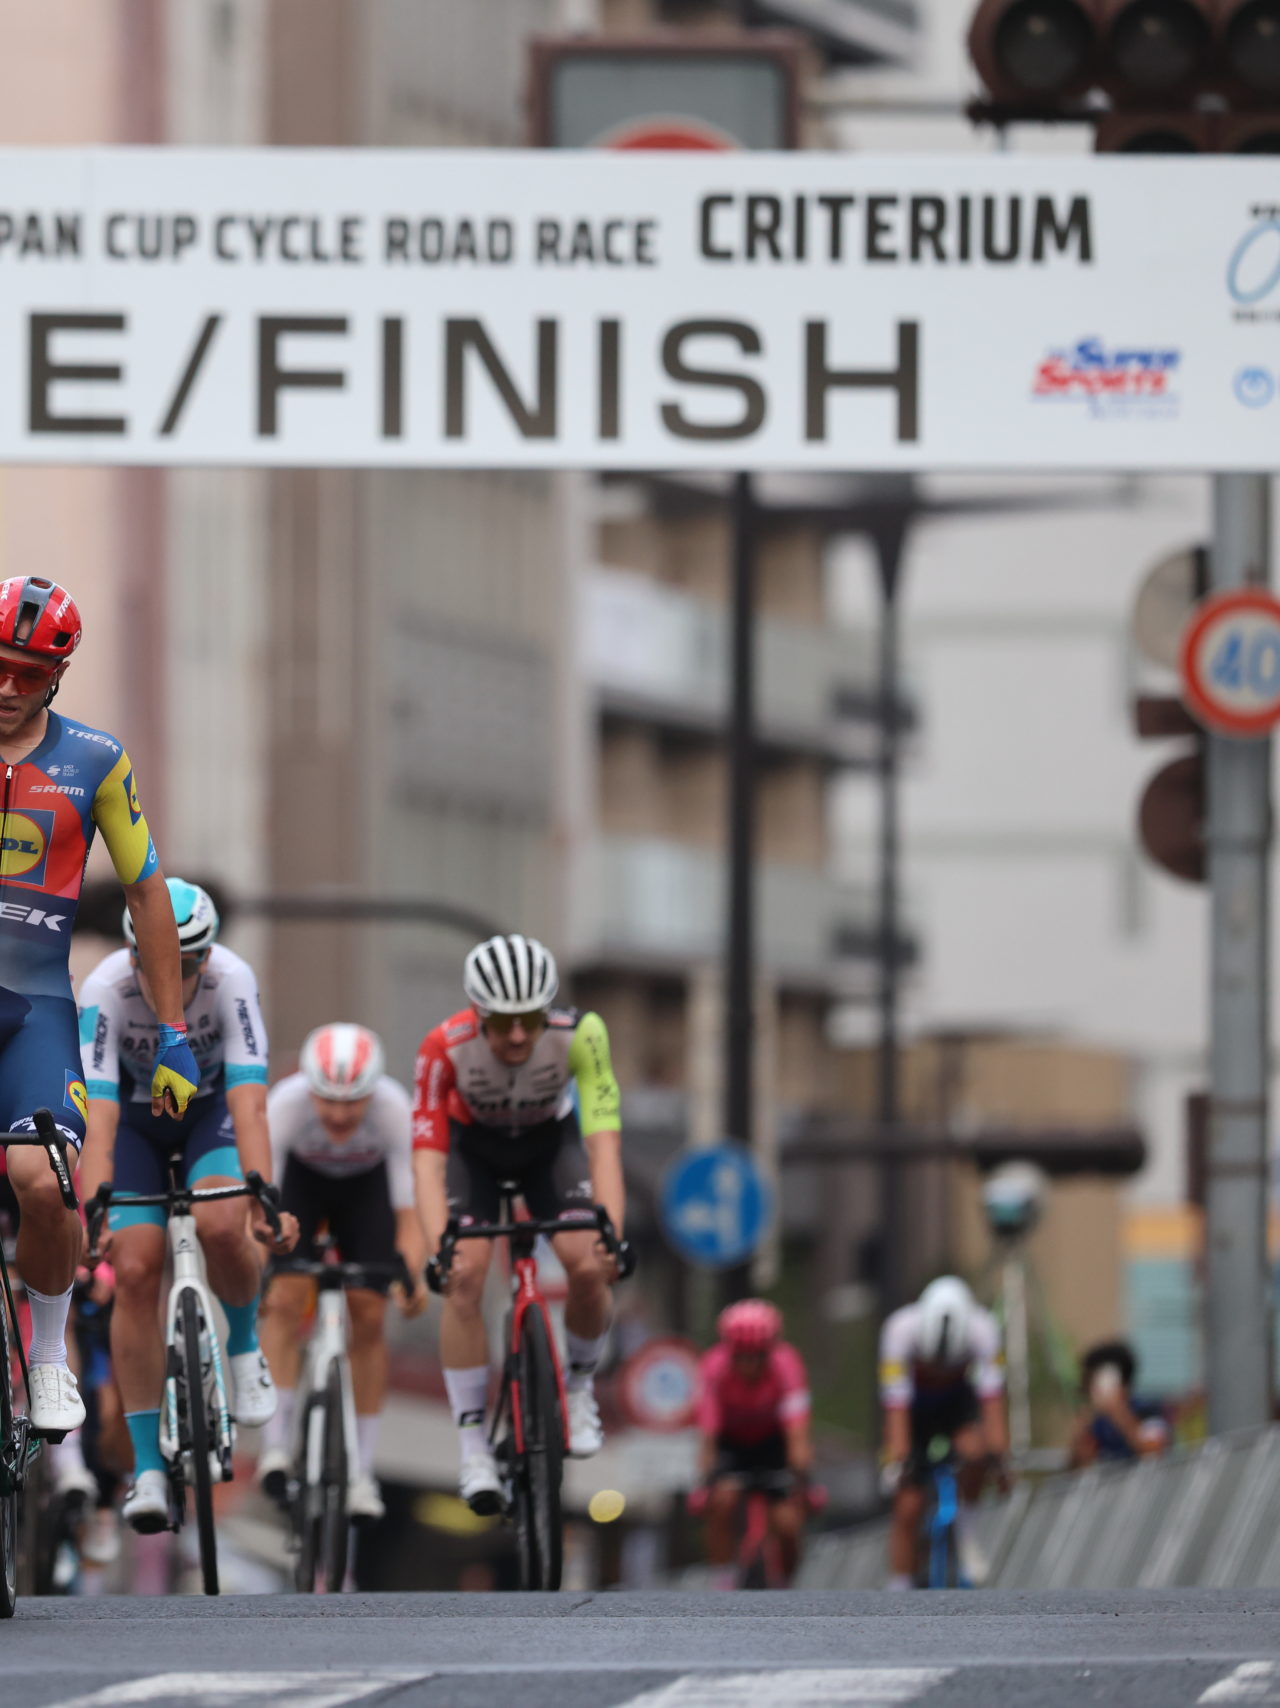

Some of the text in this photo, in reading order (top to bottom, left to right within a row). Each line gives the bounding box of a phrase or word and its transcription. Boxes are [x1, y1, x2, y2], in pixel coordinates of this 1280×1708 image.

[103, 212, 200, 262] CUP
[213, 214, 363, 264] CYCLE
[384, 216, 515, 266] ROAD
[534, 218, 657, 267] RACE
[697, 192, 1094, 265] CRITERIUM
[1210, 627, 1280, 697] 40
[66, 726, 120, 754] TREK
[29, 784, 85, 798] SRAM
